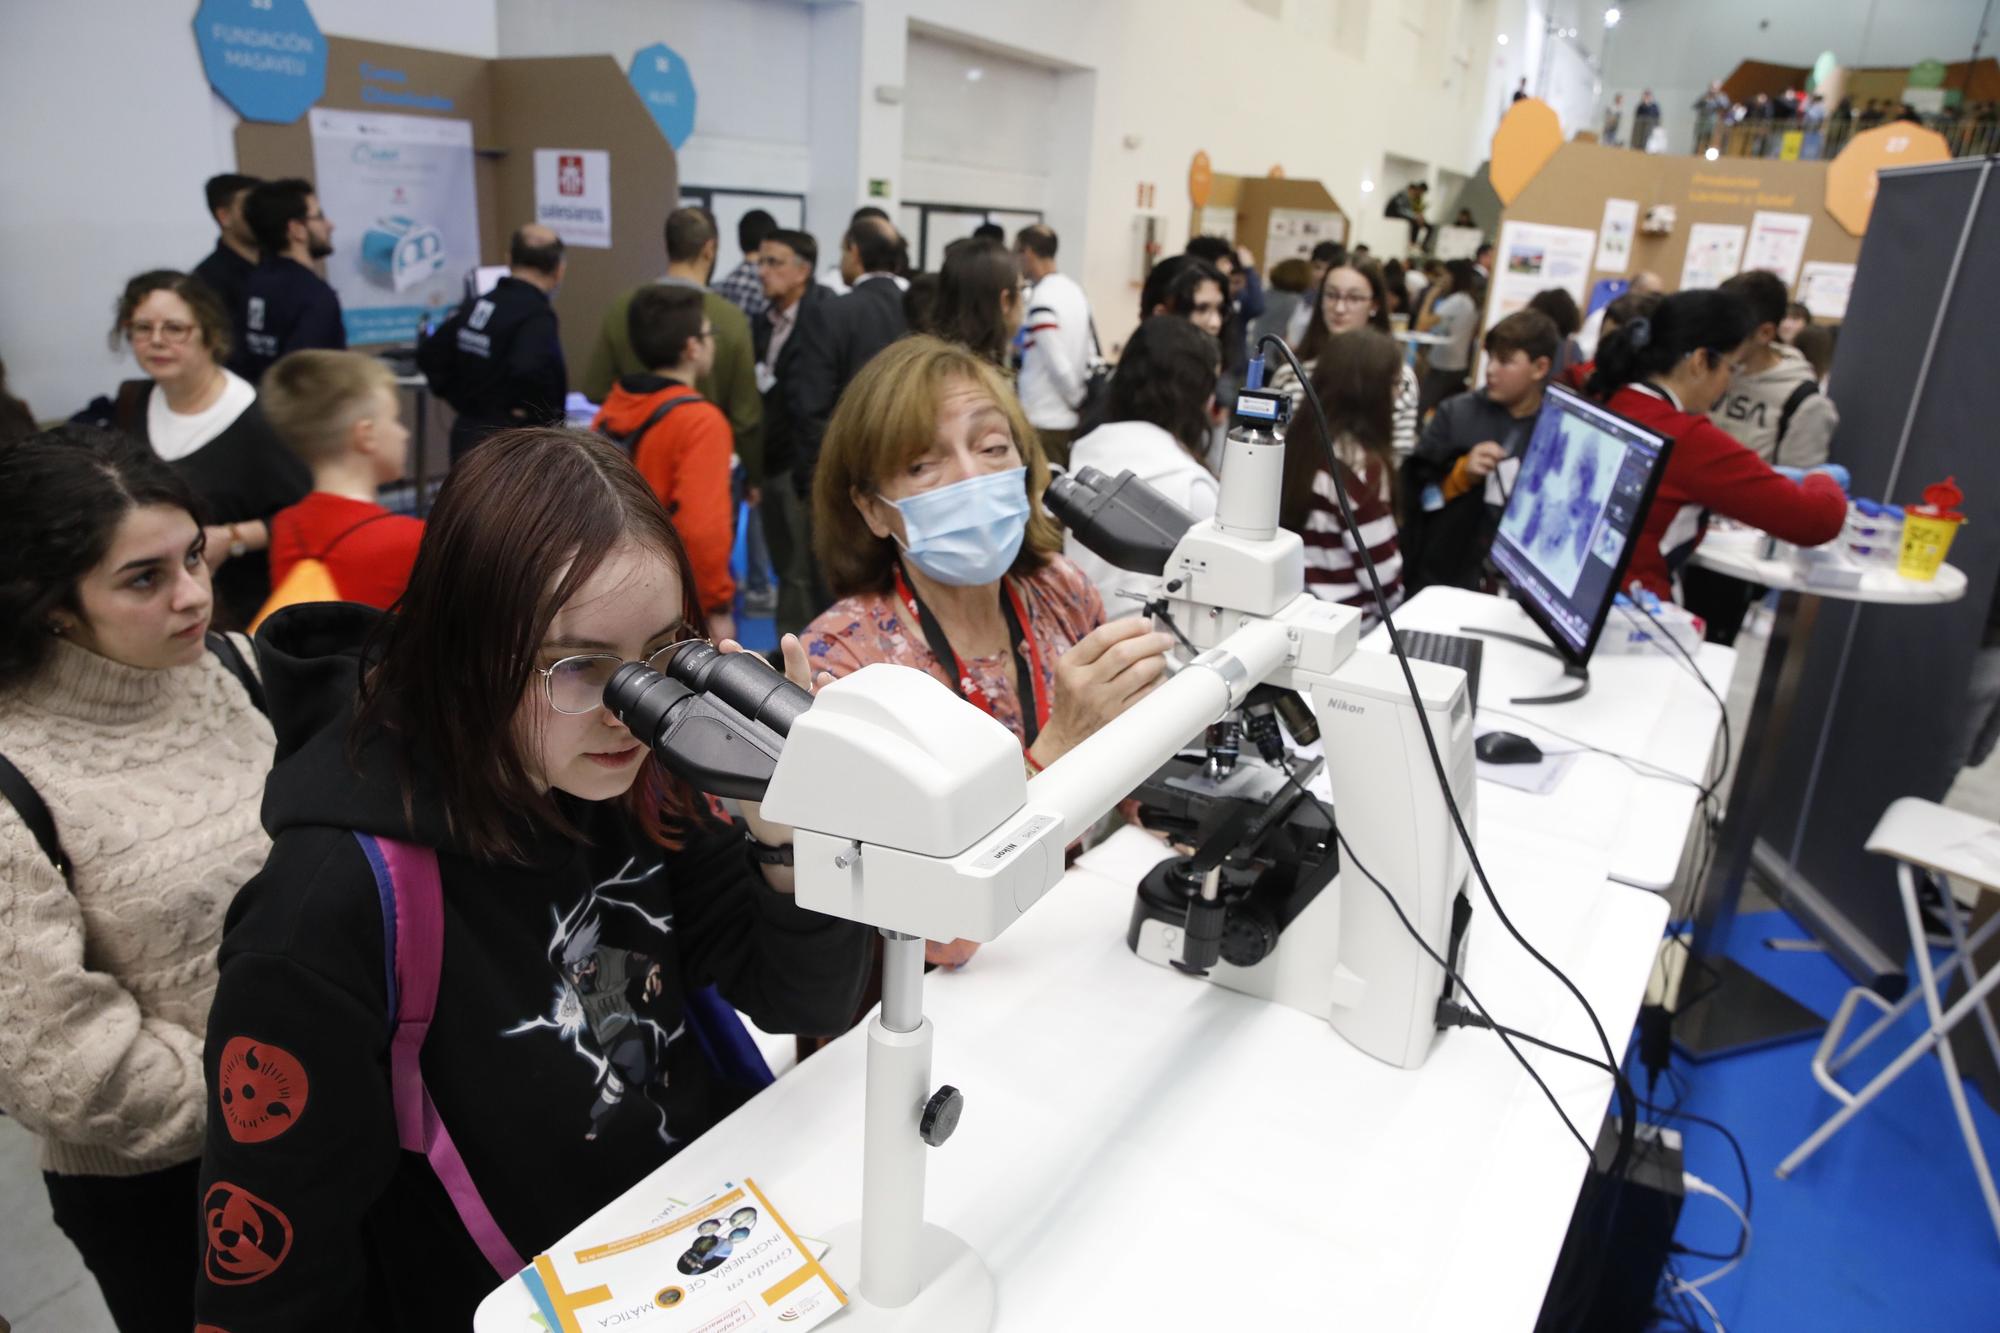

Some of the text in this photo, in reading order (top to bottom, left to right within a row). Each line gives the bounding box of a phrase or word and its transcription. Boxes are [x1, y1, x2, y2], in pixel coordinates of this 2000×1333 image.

[1327, 697, 1366, 716] Nikon
[993, 842, 1018, 859] Nikon
[710, 1233, 781, 1279] INGENIERÍA
